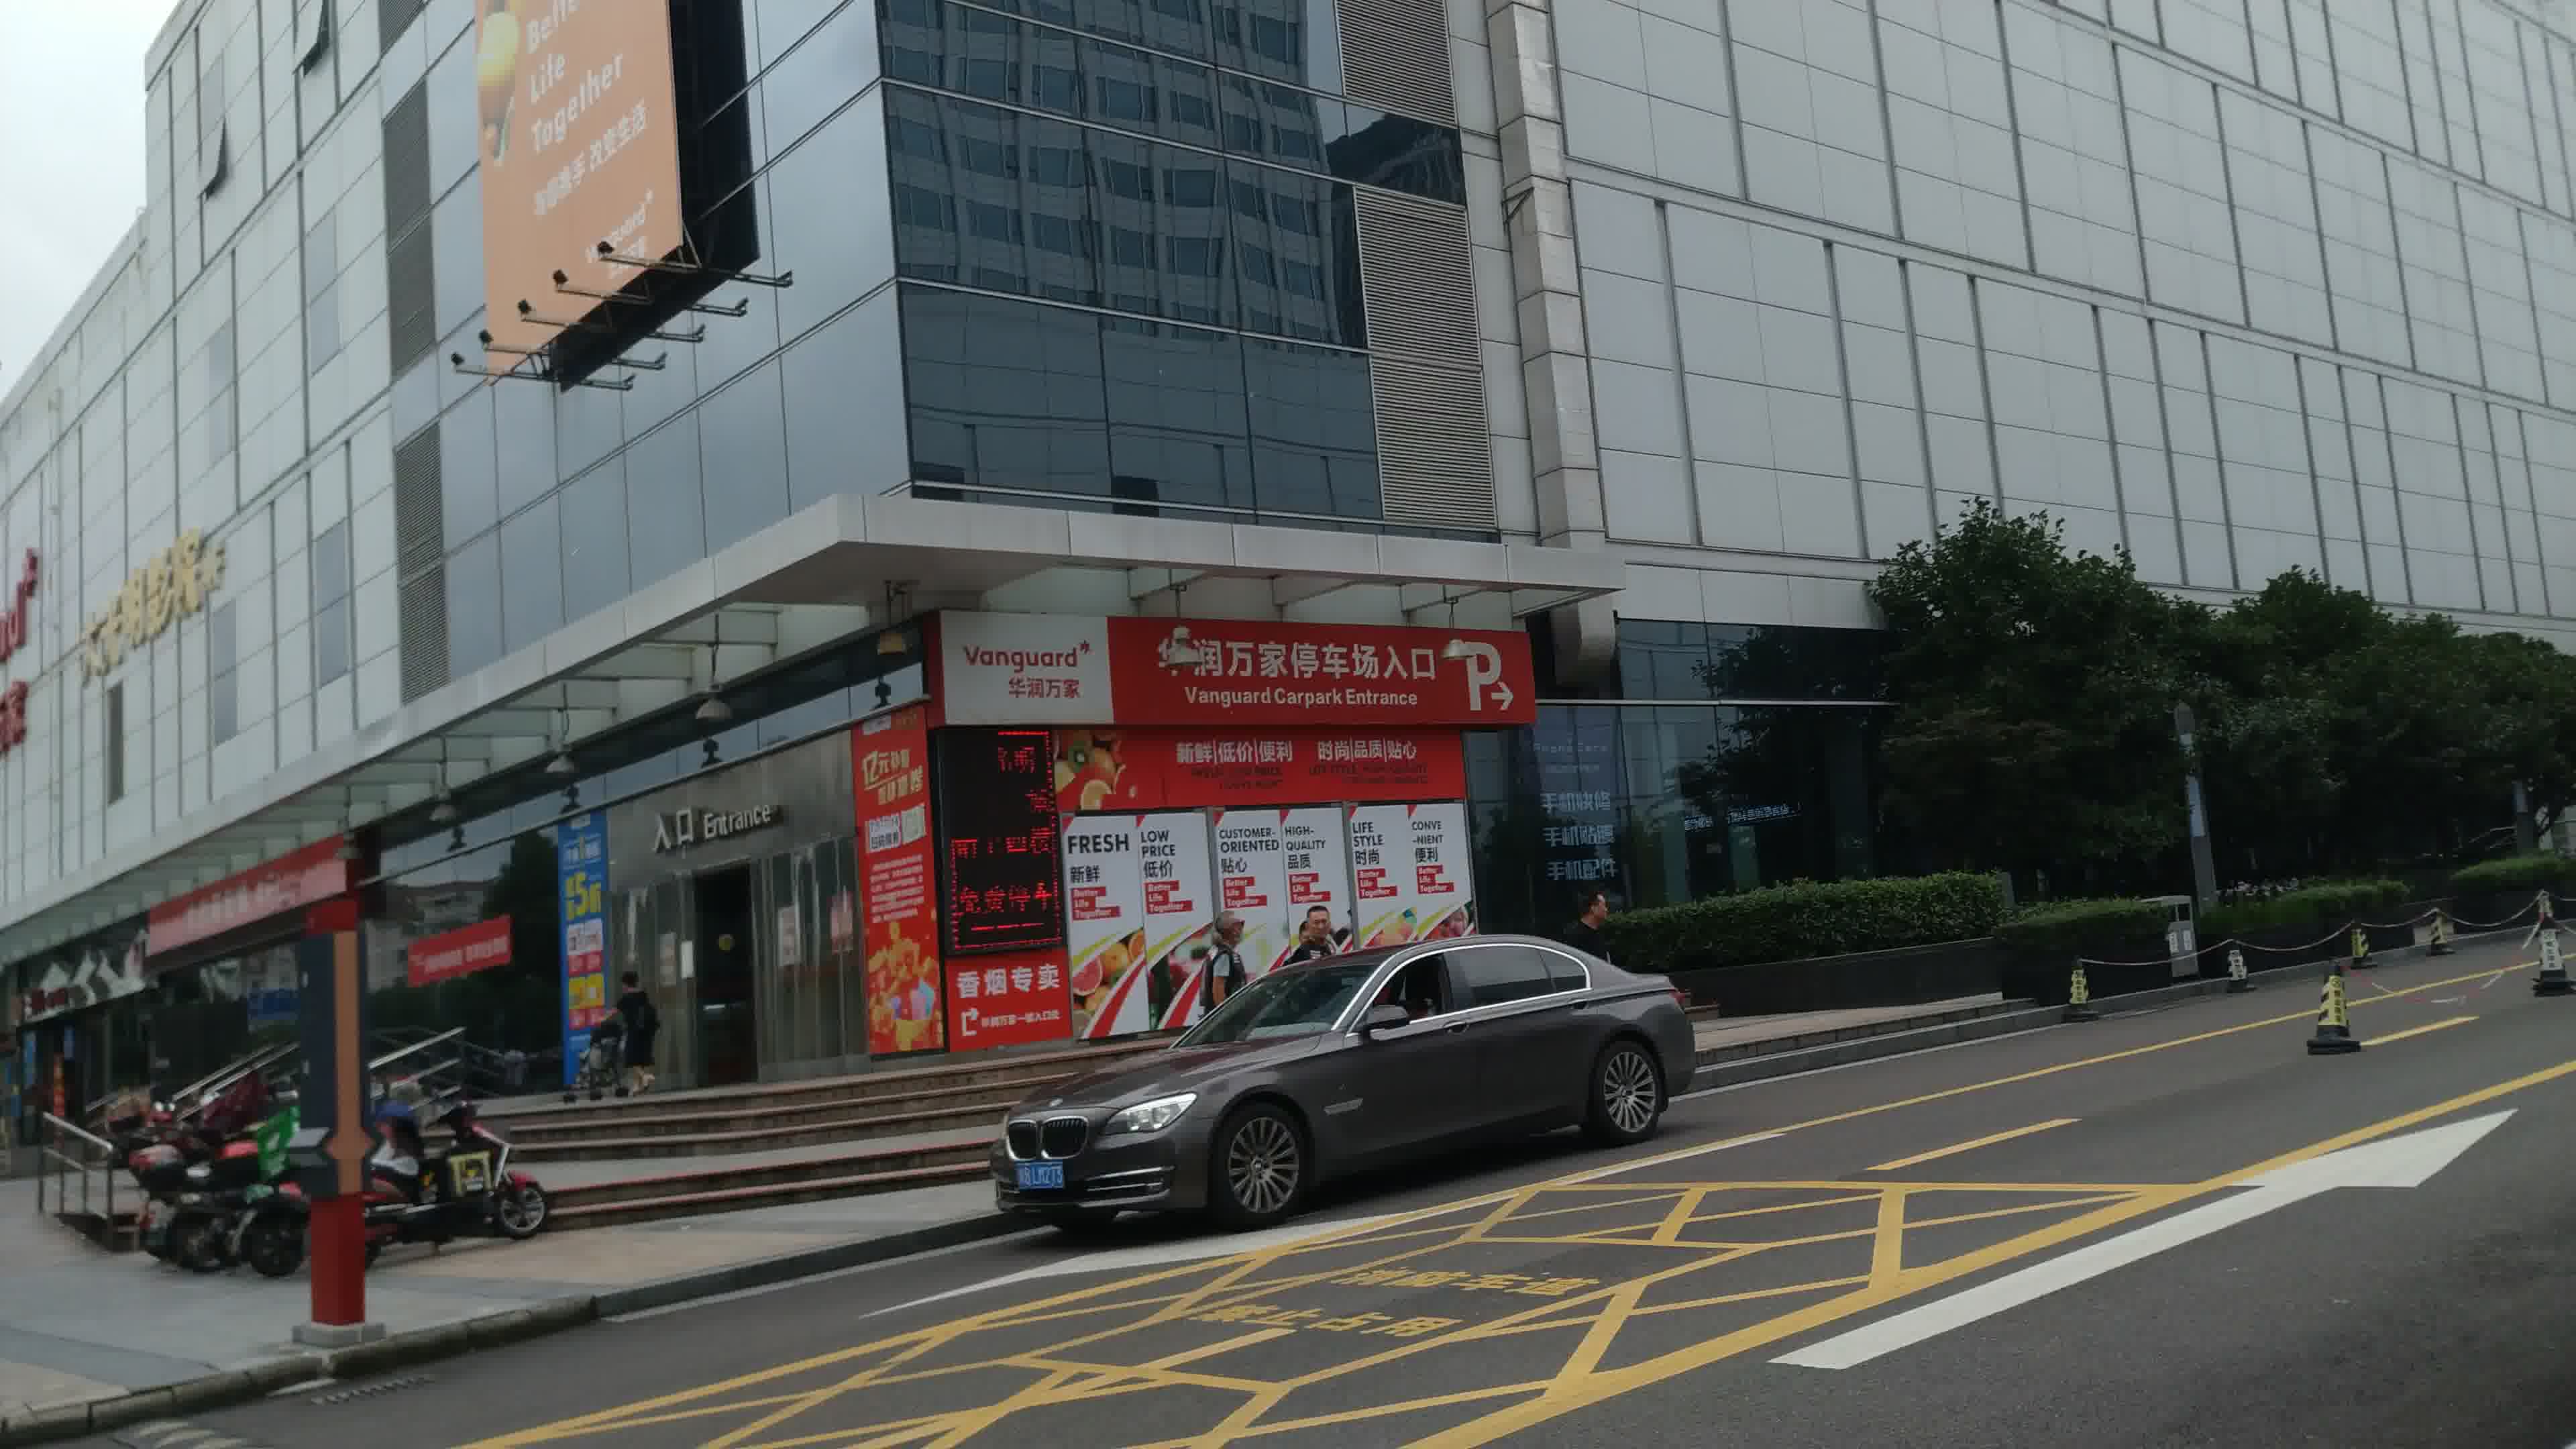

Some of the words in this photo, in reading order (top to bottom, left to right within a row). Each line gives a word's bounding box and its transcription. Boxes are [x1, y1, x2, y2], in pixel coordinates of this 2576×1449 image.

[530, 53, 566, 103] Life
[531, 52, 623, 154] Together
[963, 643, 1079, 673] Vanguard
[1008, 678, 1081, 698] 华润万家
[1185, 686, 1272, 708] Vanguard
[1275, 688, 1343, 709] Carpark
[1346, 688, 1418, 706] Entrance
[652, 808, 695, 854] 入口
[702, 804, 771, 839] Entrance
[1141, 830, 1170, 843] LOW
[1220, 826, 1276, 839] CUSTOMER-
[1285, 826, 1314, 838] HIGH-
[1352, 822, 1374, 835] LIFE
[1067, 833, 1130, 854] FRESH
[1220, 840, 1280, 854] ORIENTED
[1286, 840, 1326, 851] QUALITY
[1353, 835, 1385, 848] STYLE
[1142, 845, 1175, 859] PRICE
[1355, 849, 1380, 865] 时尚
[1415, 847, 1438, 862] 便利
[1144, 860, 1173, 878] 低价
[1221, 857, 1247, 873] 贴心
[1288, 853, 1311, 869] 品质
[1546, 858, 1619, 881] 手机配件
[1070, 865, 1101, 883] 新鲜
[959, 880, 1053, 914] 免费停车
[957, 963, 1061, 999] 香烟专卖
